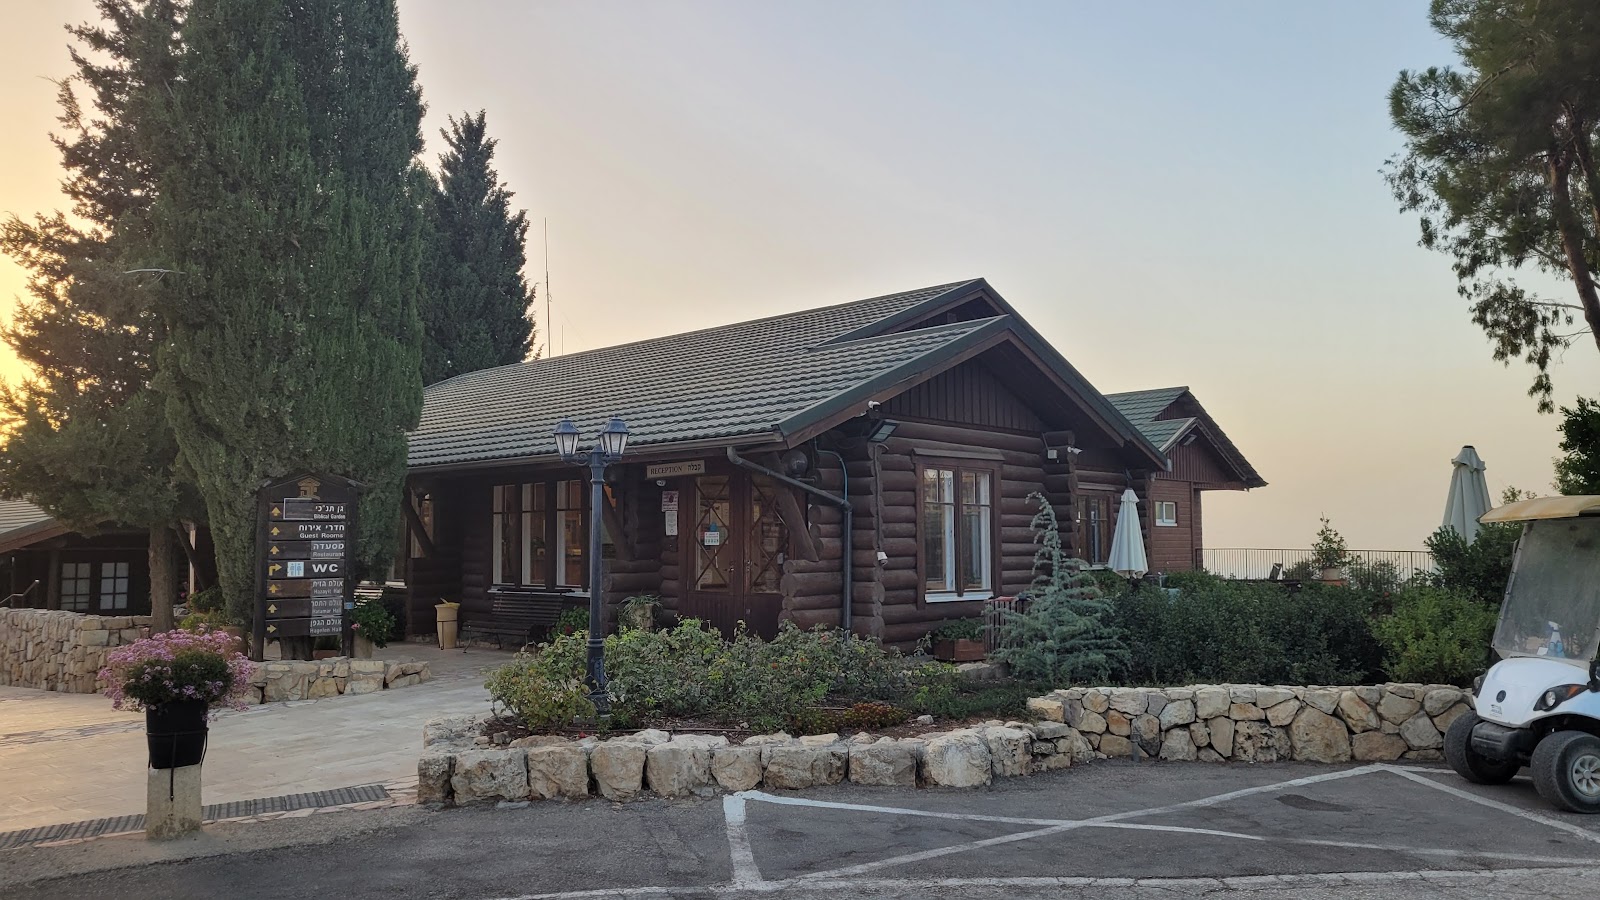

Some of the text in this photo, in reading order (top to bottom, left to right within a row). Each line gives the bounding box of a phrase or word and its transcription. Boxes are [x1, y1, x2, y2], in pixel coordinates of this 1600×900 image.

[650, 465, 683, 475] RECEPTION
[687, 462, 701, 471] קבלה
[337, 505, 344, 513] גן
[312, 563, 339, 573] WC
[310, 619, 325, 628] הגפן
